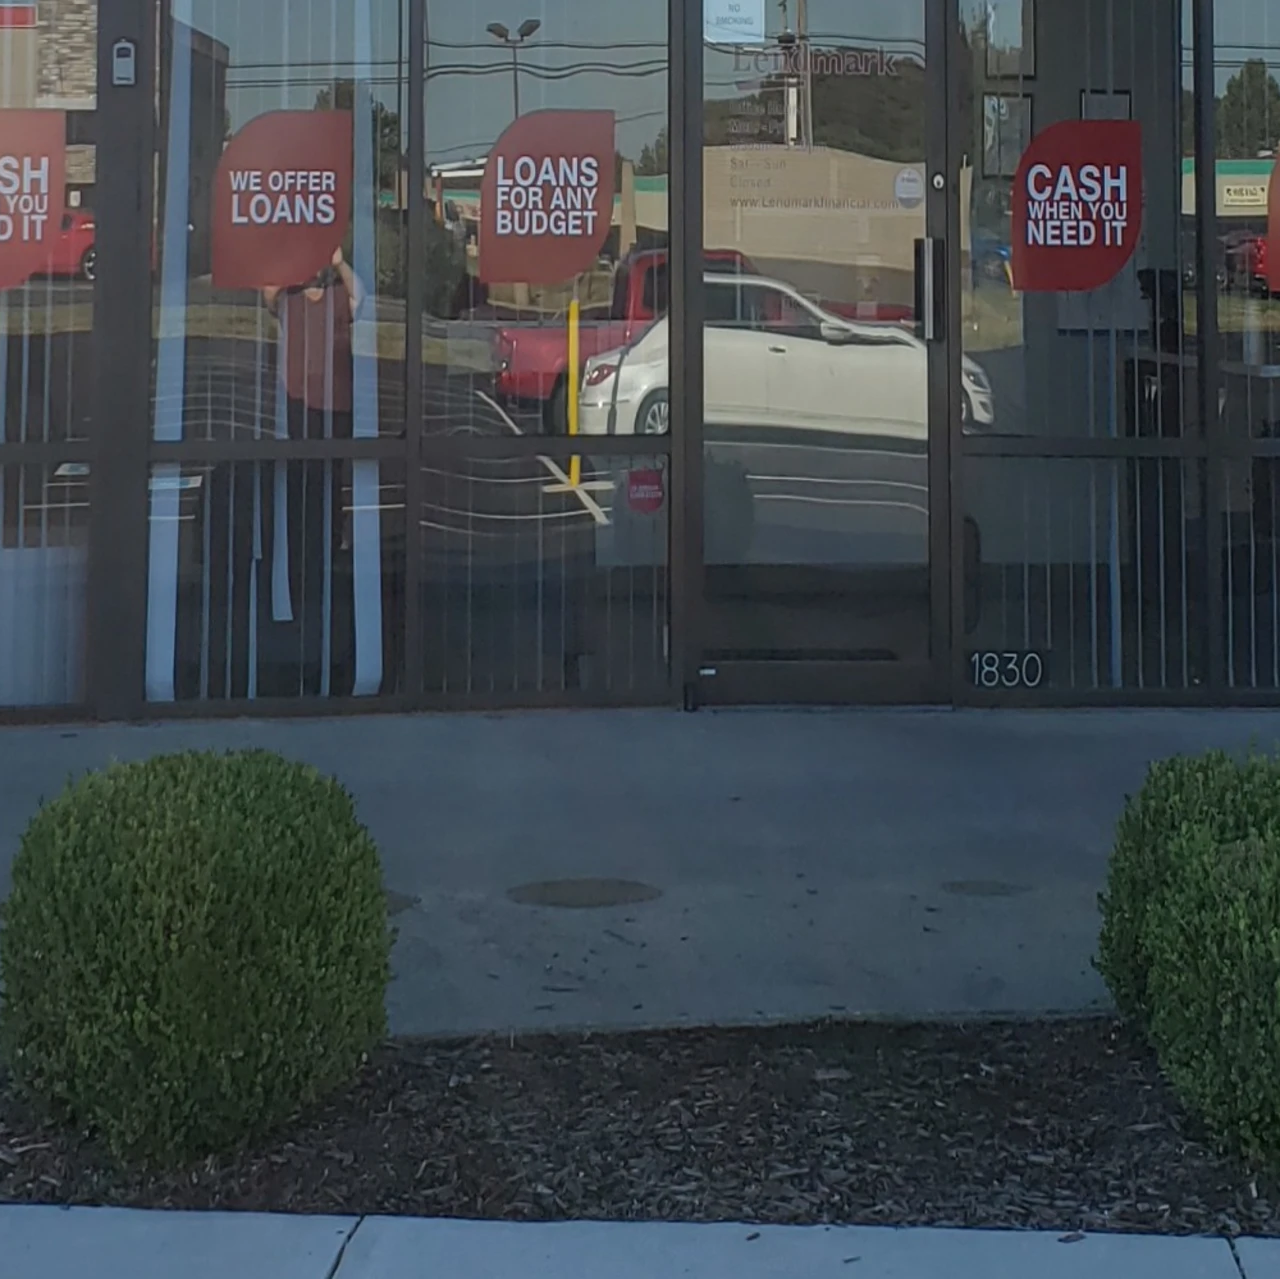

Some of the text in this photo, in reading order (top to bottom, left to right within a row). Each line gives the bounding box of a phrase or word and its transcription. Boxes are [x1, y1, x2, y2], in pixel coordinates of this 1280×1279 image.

[715, 15, 755, 26] SMOKING
[727, 3, 741, 13] NO
[732, 45, 898, 77] Lendmark
[228, 170, 336, 192] WE OFFER
[497, 155, 599, 188] LOANS
[1027, 163, 1127, 202] CASH
[6, 194, 48, 214] YOU
[231, 193, 336, 224] LOANS
[497, 186, 598, 210] FOR ANY
[1028, 201, 1127, 220] WHEN YOU
[23, 215, 48, 241] IT
[497, 210, 598, 236] BUDGET
[1028, 220, 1127, 247] NEED IT
[972, 652, 1042, 686] 1830
